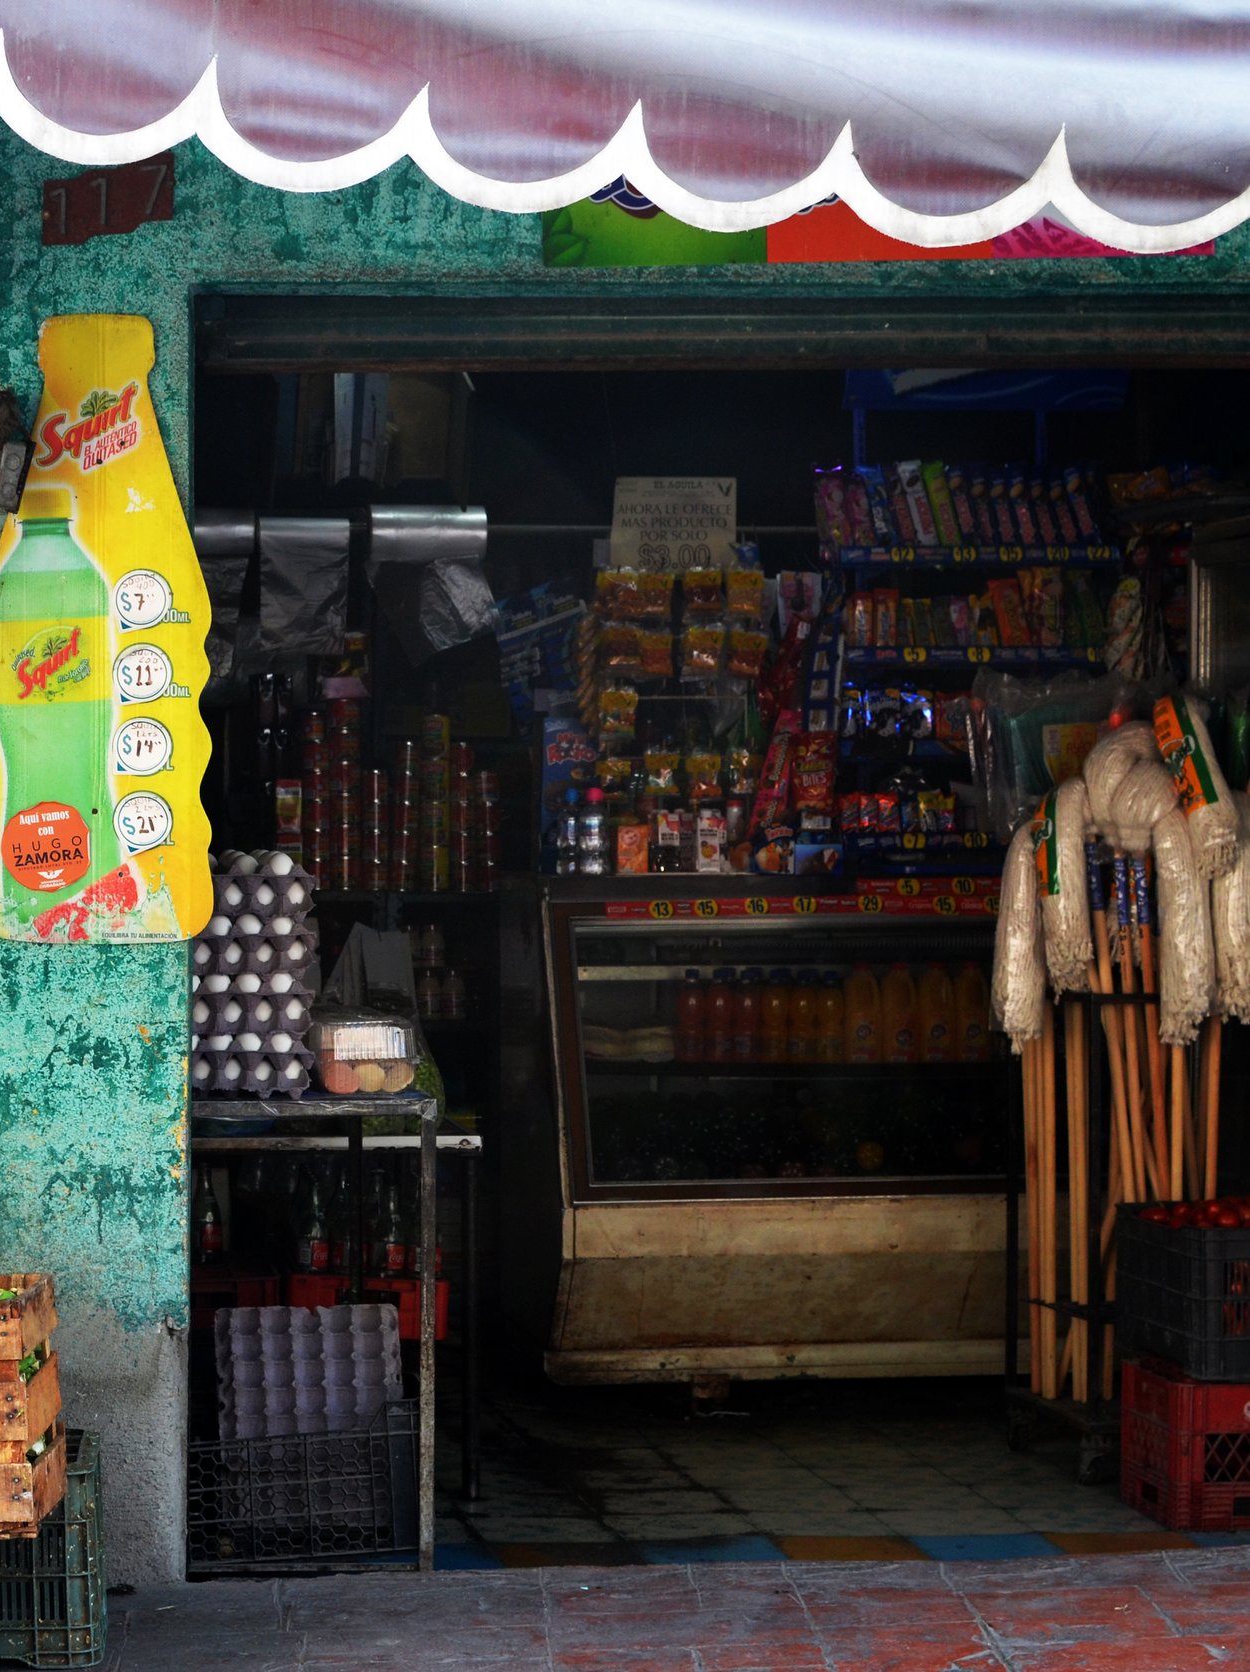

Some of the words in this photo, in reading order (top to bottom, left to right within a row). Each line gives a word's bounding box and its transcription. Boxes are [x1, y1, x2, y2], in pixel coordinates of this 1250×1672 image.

[52, 164, 168, 235] 117
[36, 381, 138, 467] Squirt
[83, 431, 137, 471] QUITASED
[84, 444, 92, 457] EL
[618, 503, 663, 515] AHORA
[665, 503, 680, 515] LE
[683, 504, 732, 515] OFRECE
[652, 517, 727, 528] PRODUCTO
[640, 530, 667, 541] POR
[671, 530, 708, 541] SOLO
[638, 543, 711, 569] $3.00
[18, 626, 82, 700] Squirt
[19, 812, 39, 826] Aquí
[41, 810, 70, 823] vamos
[37, 825, 54, 837] con
[12, 835, 82, 854] HUGO
[14, 847, 84, 867] ZAMORA
